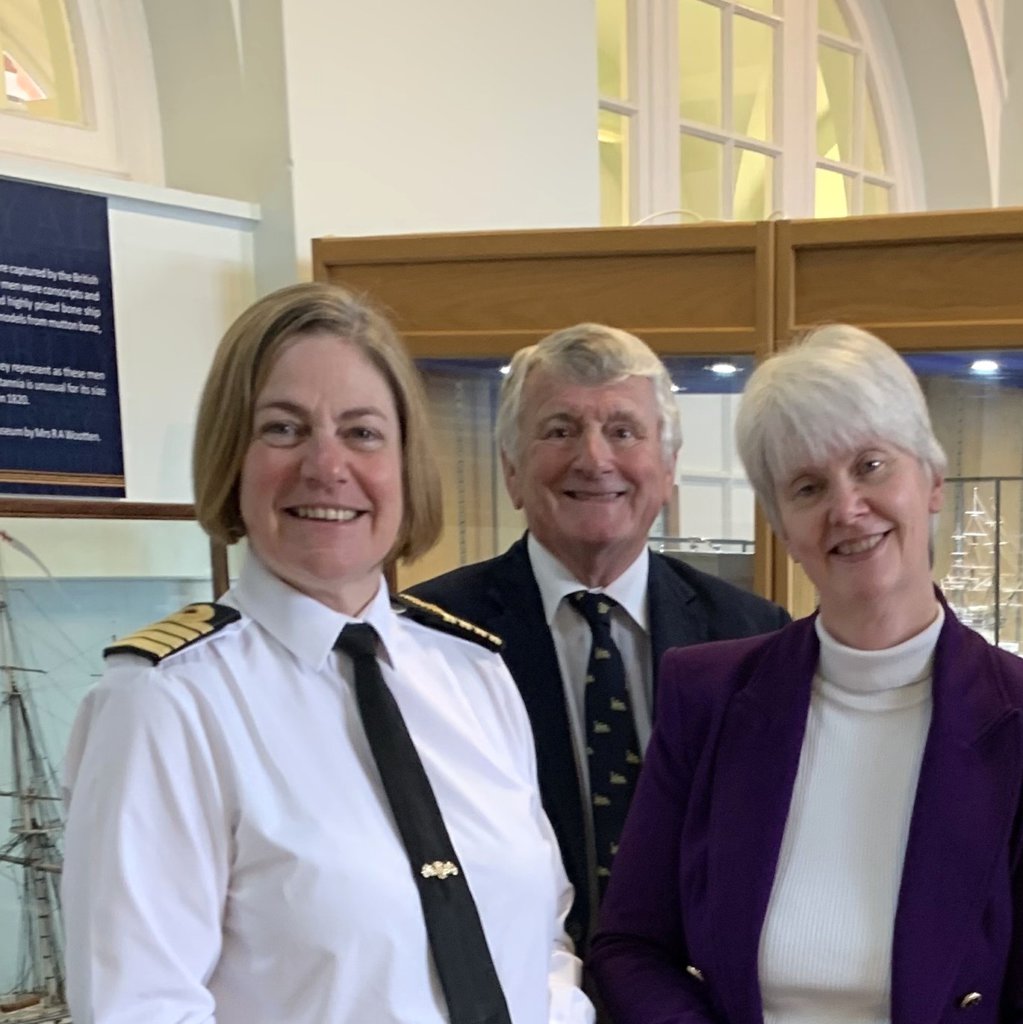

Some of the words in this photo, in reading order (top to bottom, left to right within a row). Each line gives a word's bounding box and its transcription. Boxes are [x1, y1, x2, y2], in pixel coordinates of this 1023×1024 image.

[9, 265, 46, 279] captured
[46, 268, 57, 281] by
[58, 270, 72, 281] the
[73, 272, 99, 285] British
[1, 281, 21, 290] men
[22, 284, 42, 293] were
[43, 286, 83, 300] conscripts
[84, 291, 100, 301] and
[7, 296, 33, 311] highly
[34, 301, 60, 313] prized
[61, 302, 82, 315] bone
[83, 306, 102, 318] ship
[27, 314, 47, 326] from
[11, 364, 51, 376] represent
[52, 368, 62, 377] as
[63, 366, 86, 379] these
[87, 371, 105, 380] men
[26, 379, 34, 390] is
[35, 382, 66, 393] unusual
[67, 382, 79, 393] for
[80, 384, 90, 395] its
[24, 427, 34, 439] by
[35, 428, 51, 438] Mrs
